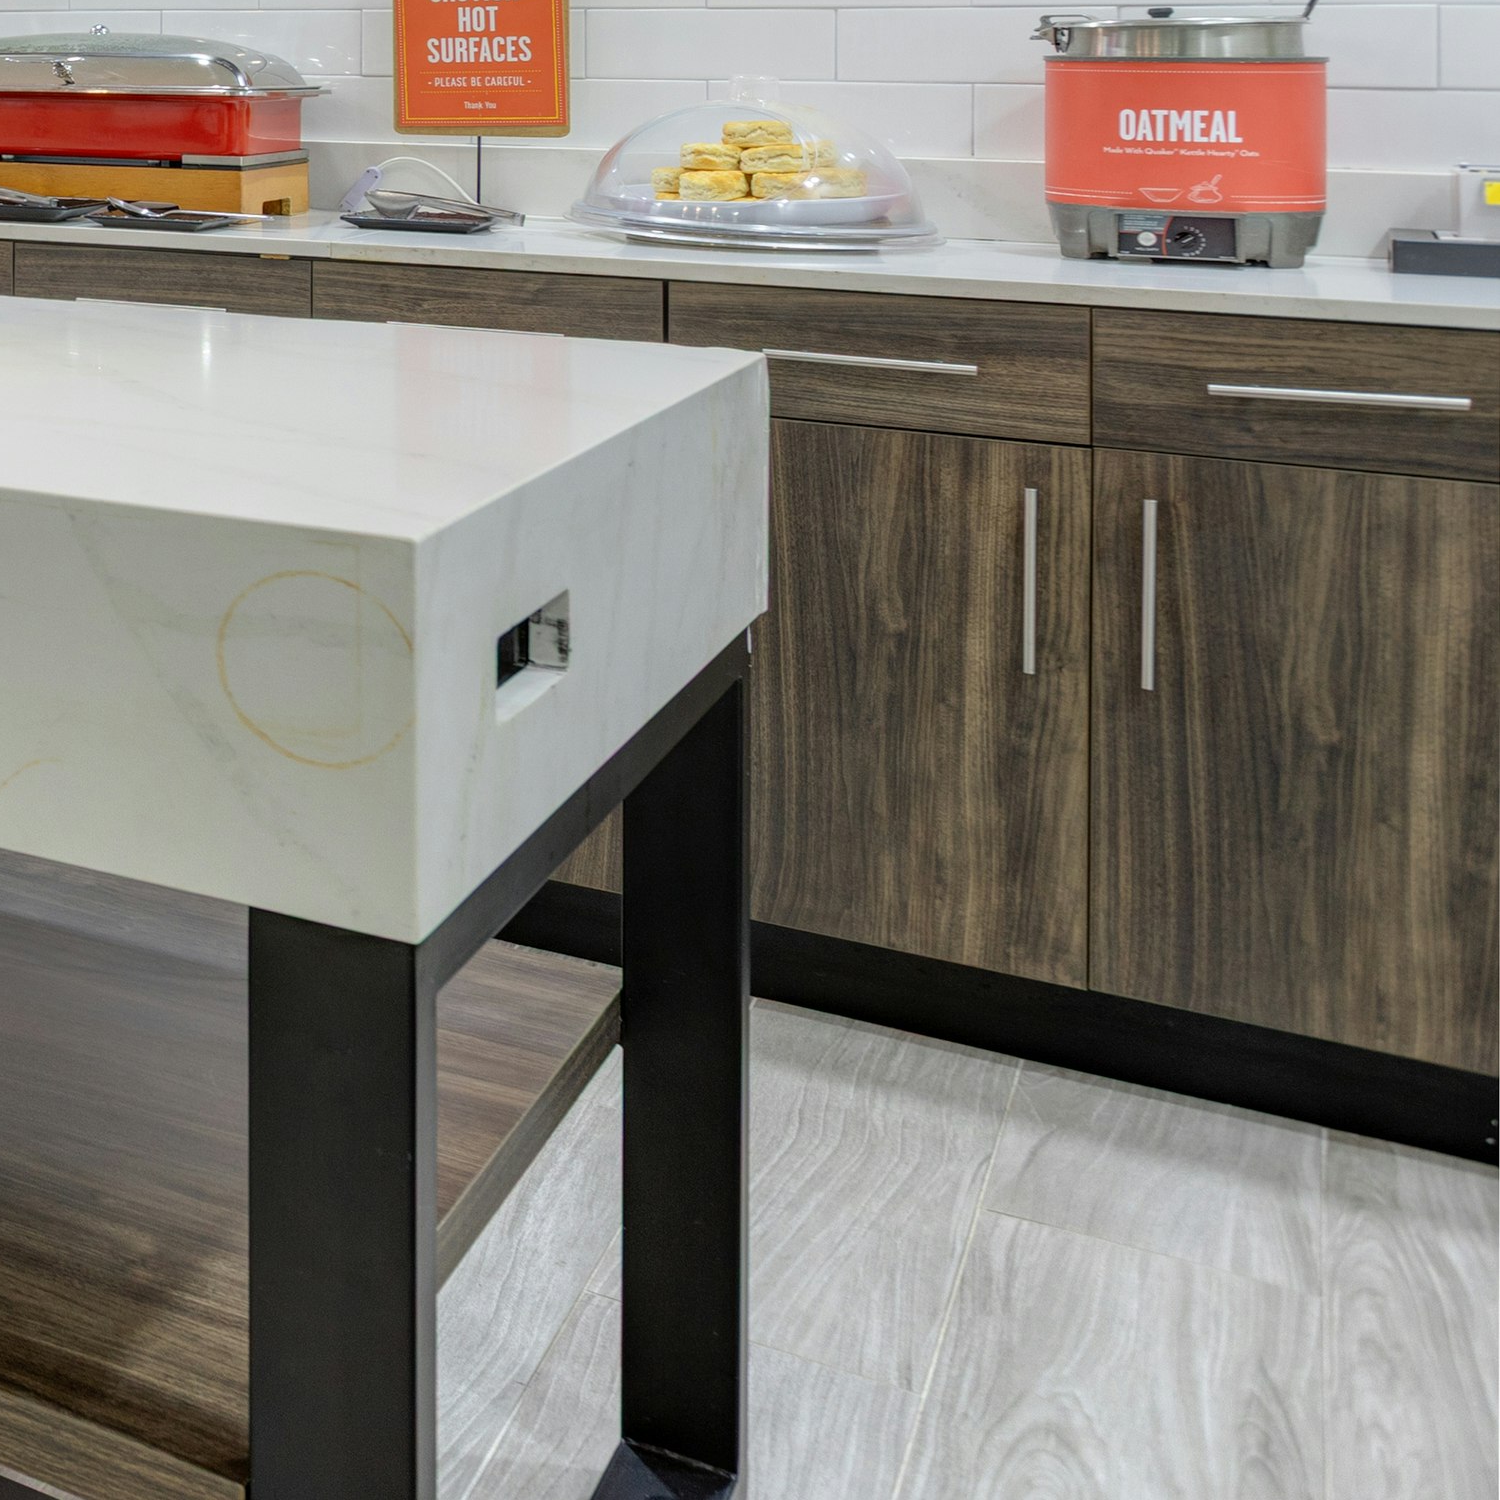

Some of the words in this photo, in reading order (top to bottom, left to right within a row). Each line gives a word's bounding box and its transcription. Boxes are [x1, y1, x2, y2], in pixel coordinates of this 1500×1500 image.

[458, 6, 498, 32] HOT
[427, 36, 532, 63] SURFACES
[435, 77, 467, 87] PLEASE
[471, 76, 481, 87] BE
[485, 76, 525, 87] CAREFUL
[464, 101, 483, 109] Thank
[485, 101, 497, 109] You
[1118, 108, 1244, 143] OATMEAL
